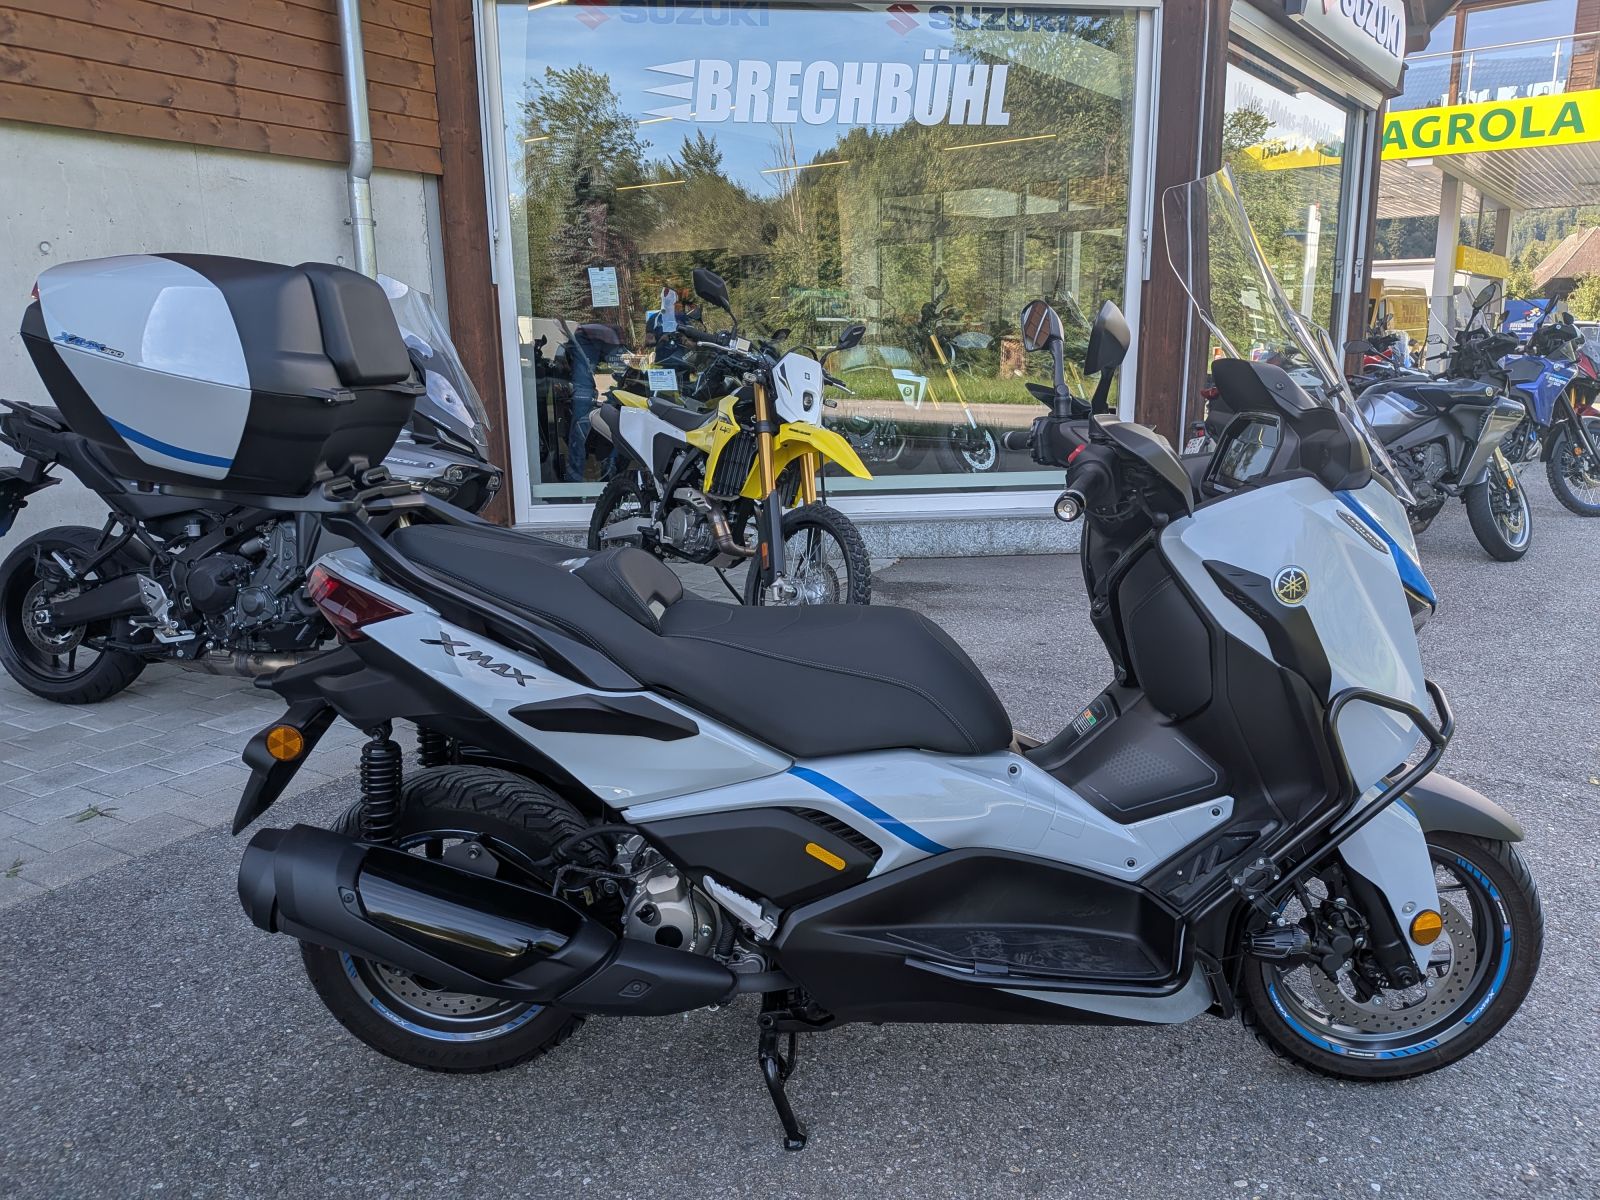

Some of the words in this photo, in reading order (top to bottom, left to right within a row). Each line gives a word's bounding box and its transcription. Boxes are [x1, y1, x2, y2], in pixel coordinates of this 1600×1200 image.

[620, 0, 770, 26] SUZUKI
[928, 5, 1069, 33] SUZUKI
[695, 49, 1010, 126] BRECHBÜHL
[1383, 101, 1586, 151] AGROLA
[419, 631, 537, 687] XMAX
